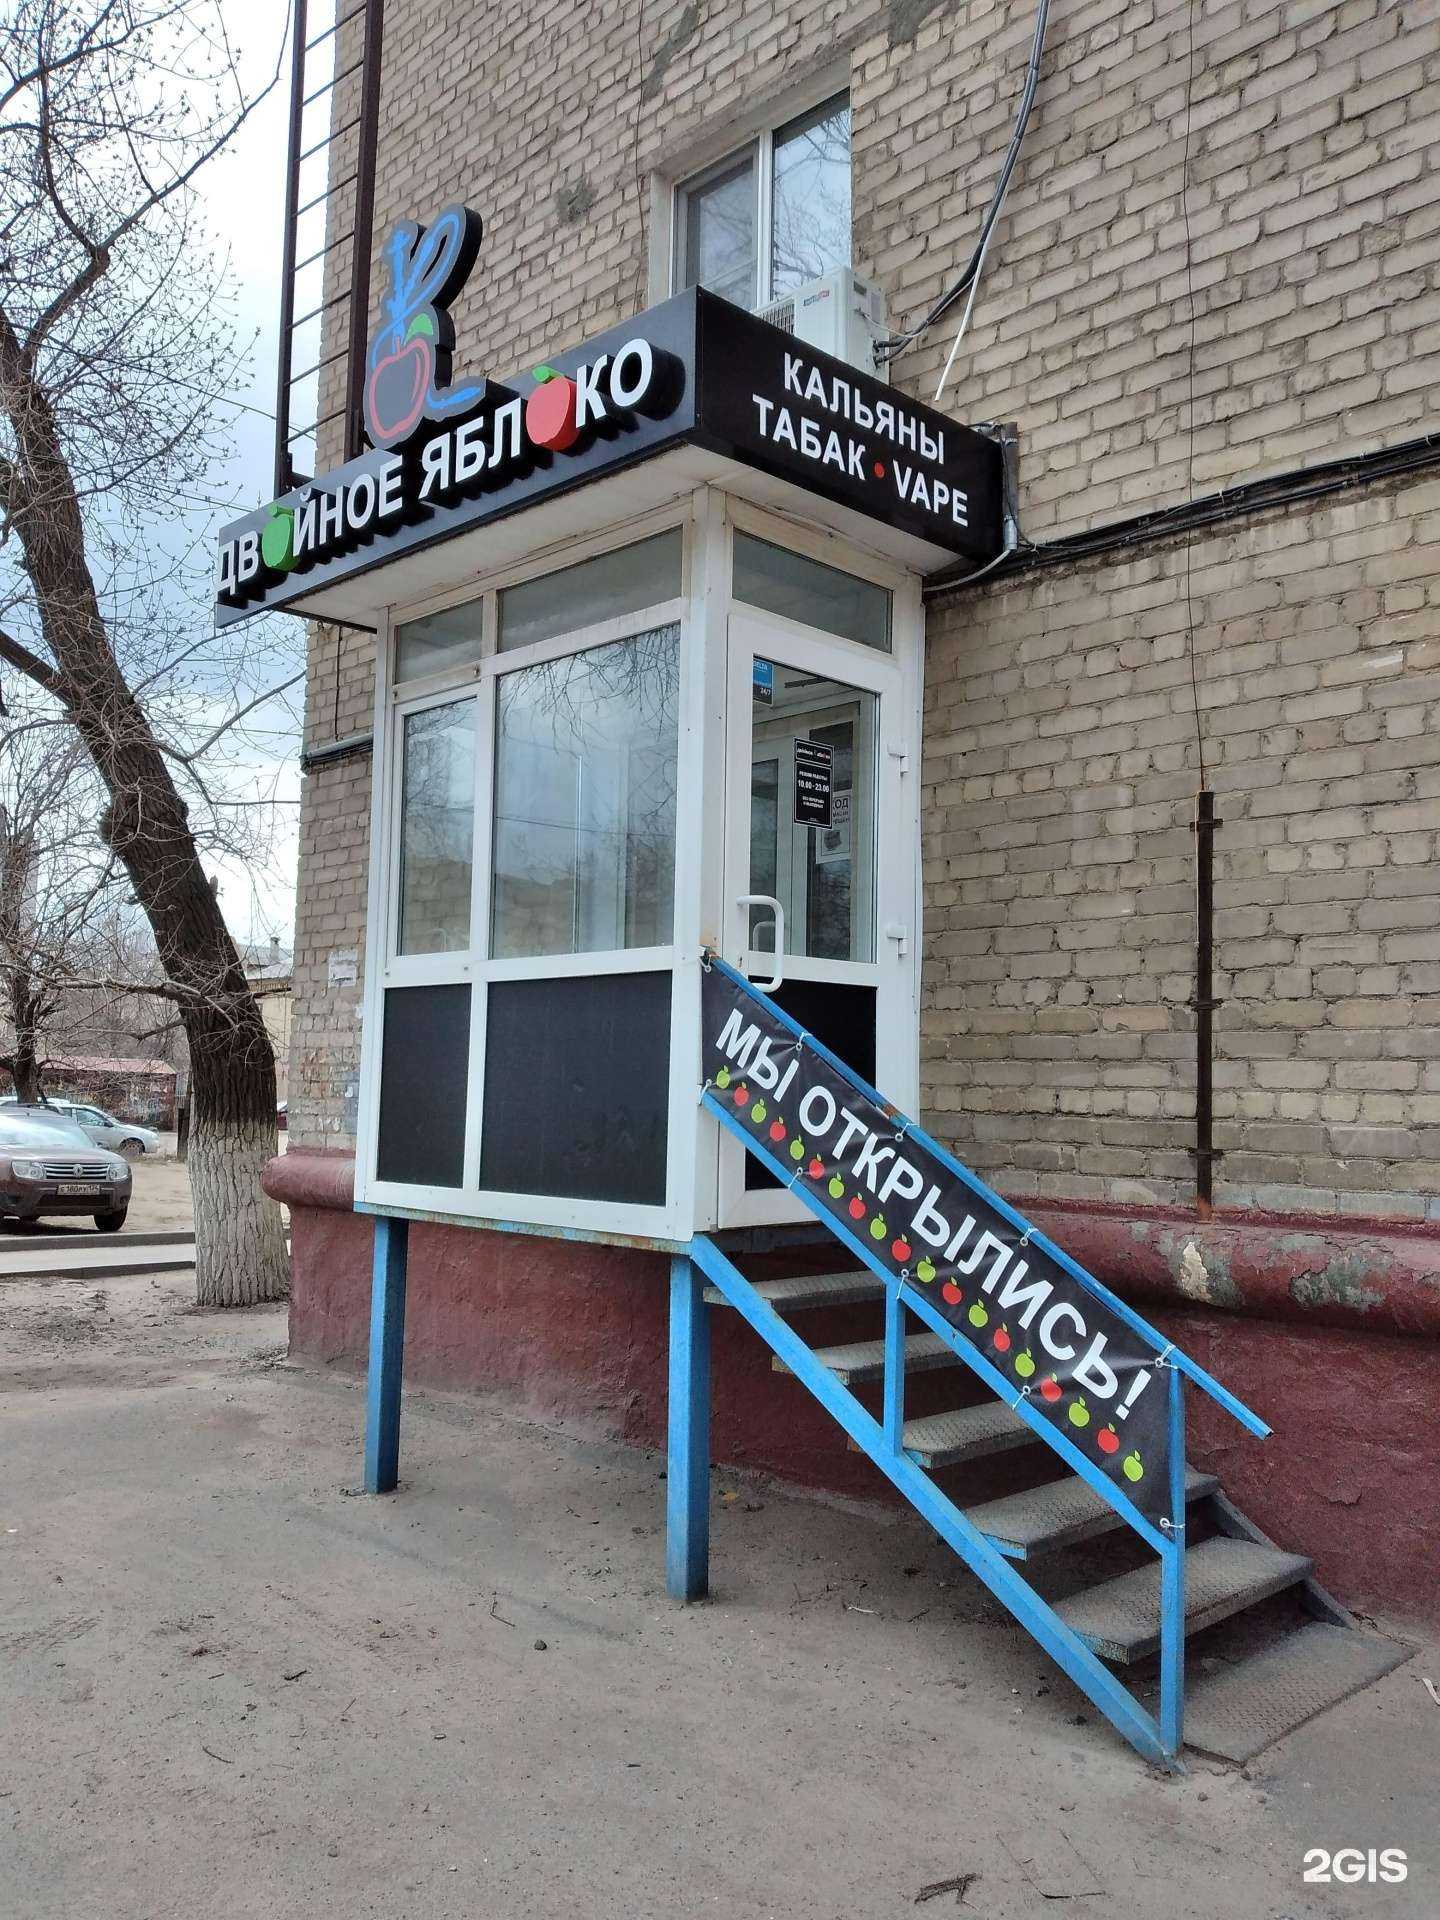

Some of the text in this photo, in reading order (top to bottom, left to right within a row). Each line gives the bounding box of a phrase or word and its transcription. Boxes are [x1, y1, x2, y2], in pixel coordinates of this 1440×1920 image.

[752, 394, 968, 527] ТАБАК VAPE
[784, 352, 944, 464] КАЛЬЯНЫ
[715, 1008, 1153, 1421] МЫ ОТКРЫЛИСЬ!
